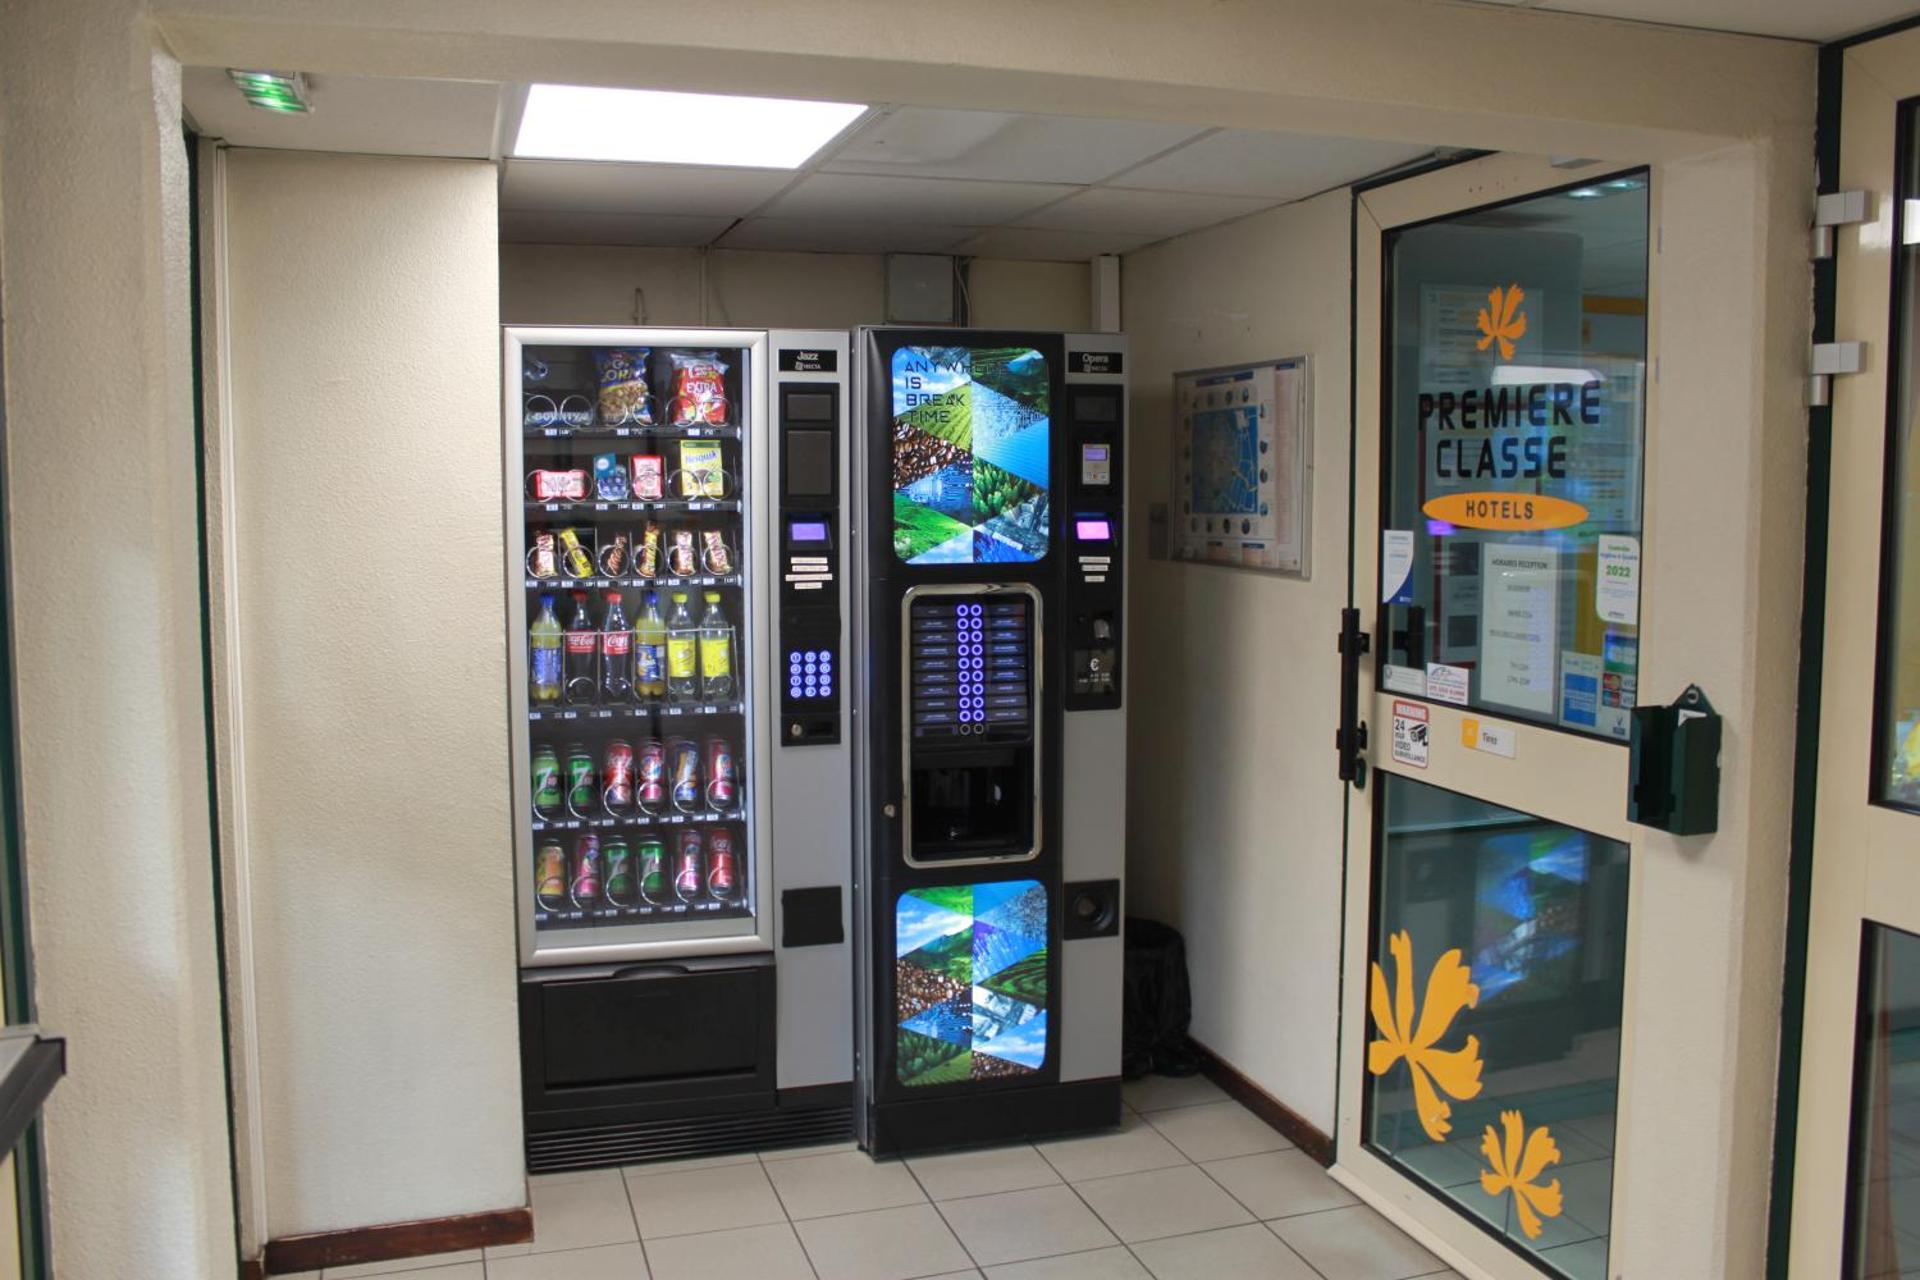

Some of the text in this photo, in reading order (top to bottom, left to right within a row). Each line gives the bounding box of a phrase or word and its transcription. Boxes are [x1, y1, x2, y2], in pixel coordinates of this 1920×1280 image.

[796, 351, 819, 361] Jazz
[905, 376, 922, 390] IS
[905, 393, 966, 407] BREAK
[1418, 380, 1601, 431] PREMIERE
[908, 410, 951, 423] TIME
[1436, 436, 1567, 479] CLASSE
[1465, 500, 1534, 520] HOTELS
[1605, 564, 1631, 578] 2022
[1394, 719, 1405, 731] 24
